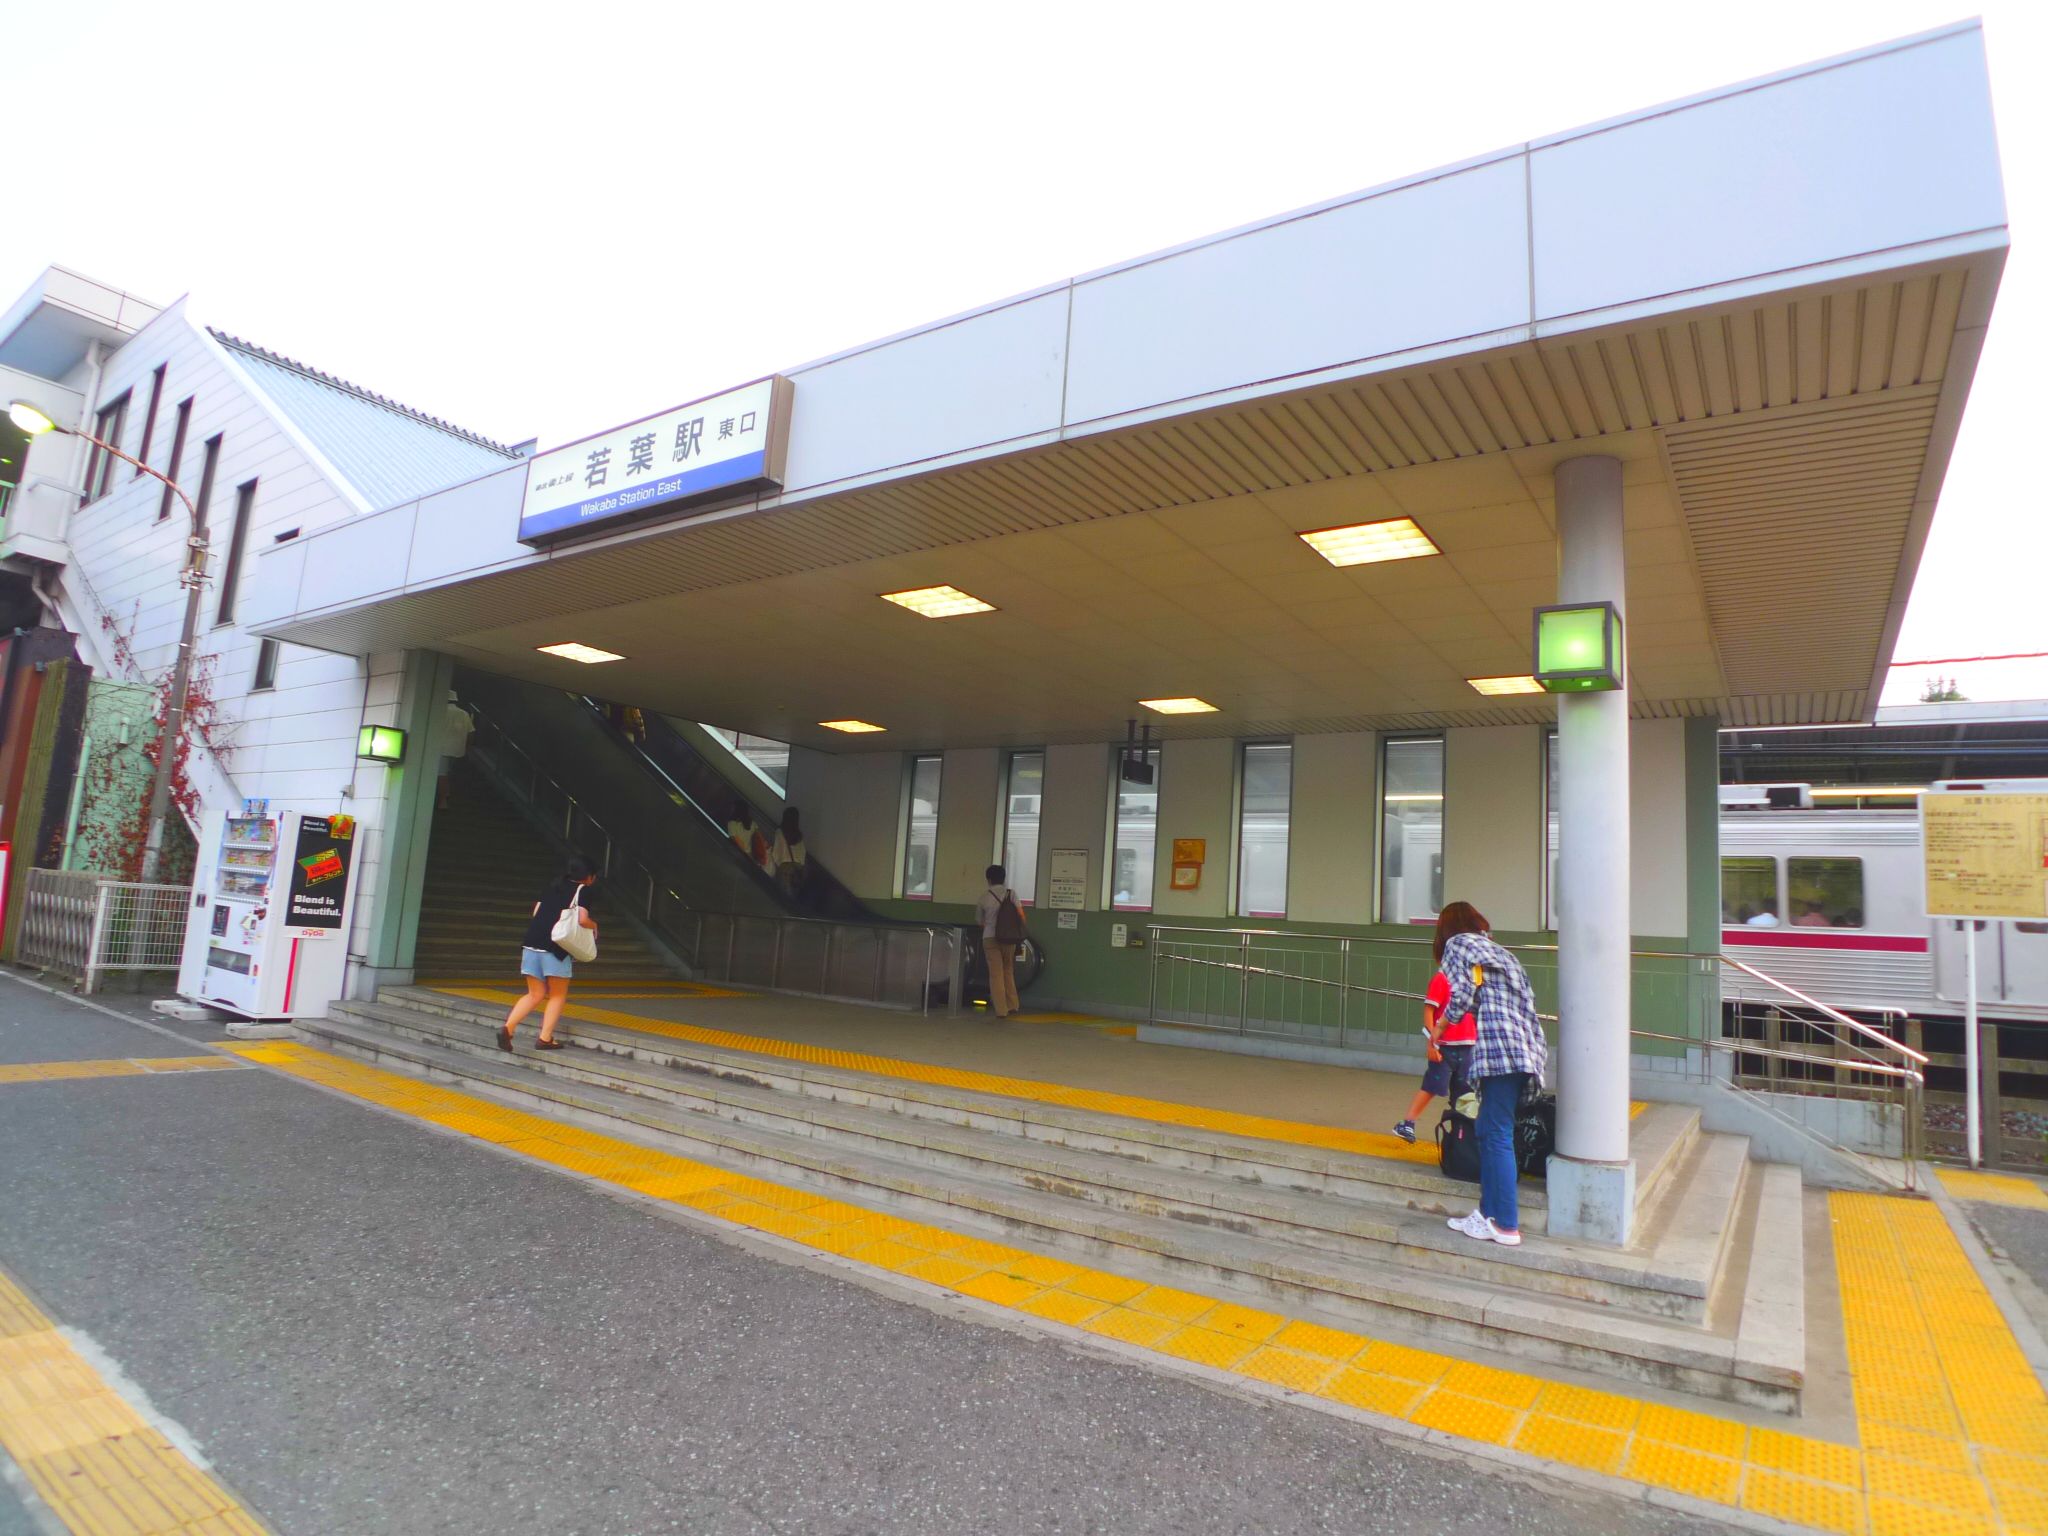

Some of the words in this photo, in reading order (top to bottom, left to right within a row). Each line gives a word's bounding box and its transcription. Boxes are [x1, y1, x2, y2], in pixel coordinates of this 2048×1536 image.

[585, 416, 704, 489] 若葉駅
[717, 411, 756, 440] 東口
[580, 499, 617, 517] Wakaba
[619, 487, 655, 506] Station
[657, 479, 682, 496] East
[294, 894, 325, 904] Blend
[325, 896, 335, 905] is
[292, 905, 341, 917] Beautiful.
[302, 929, 325, 937] DyDo
